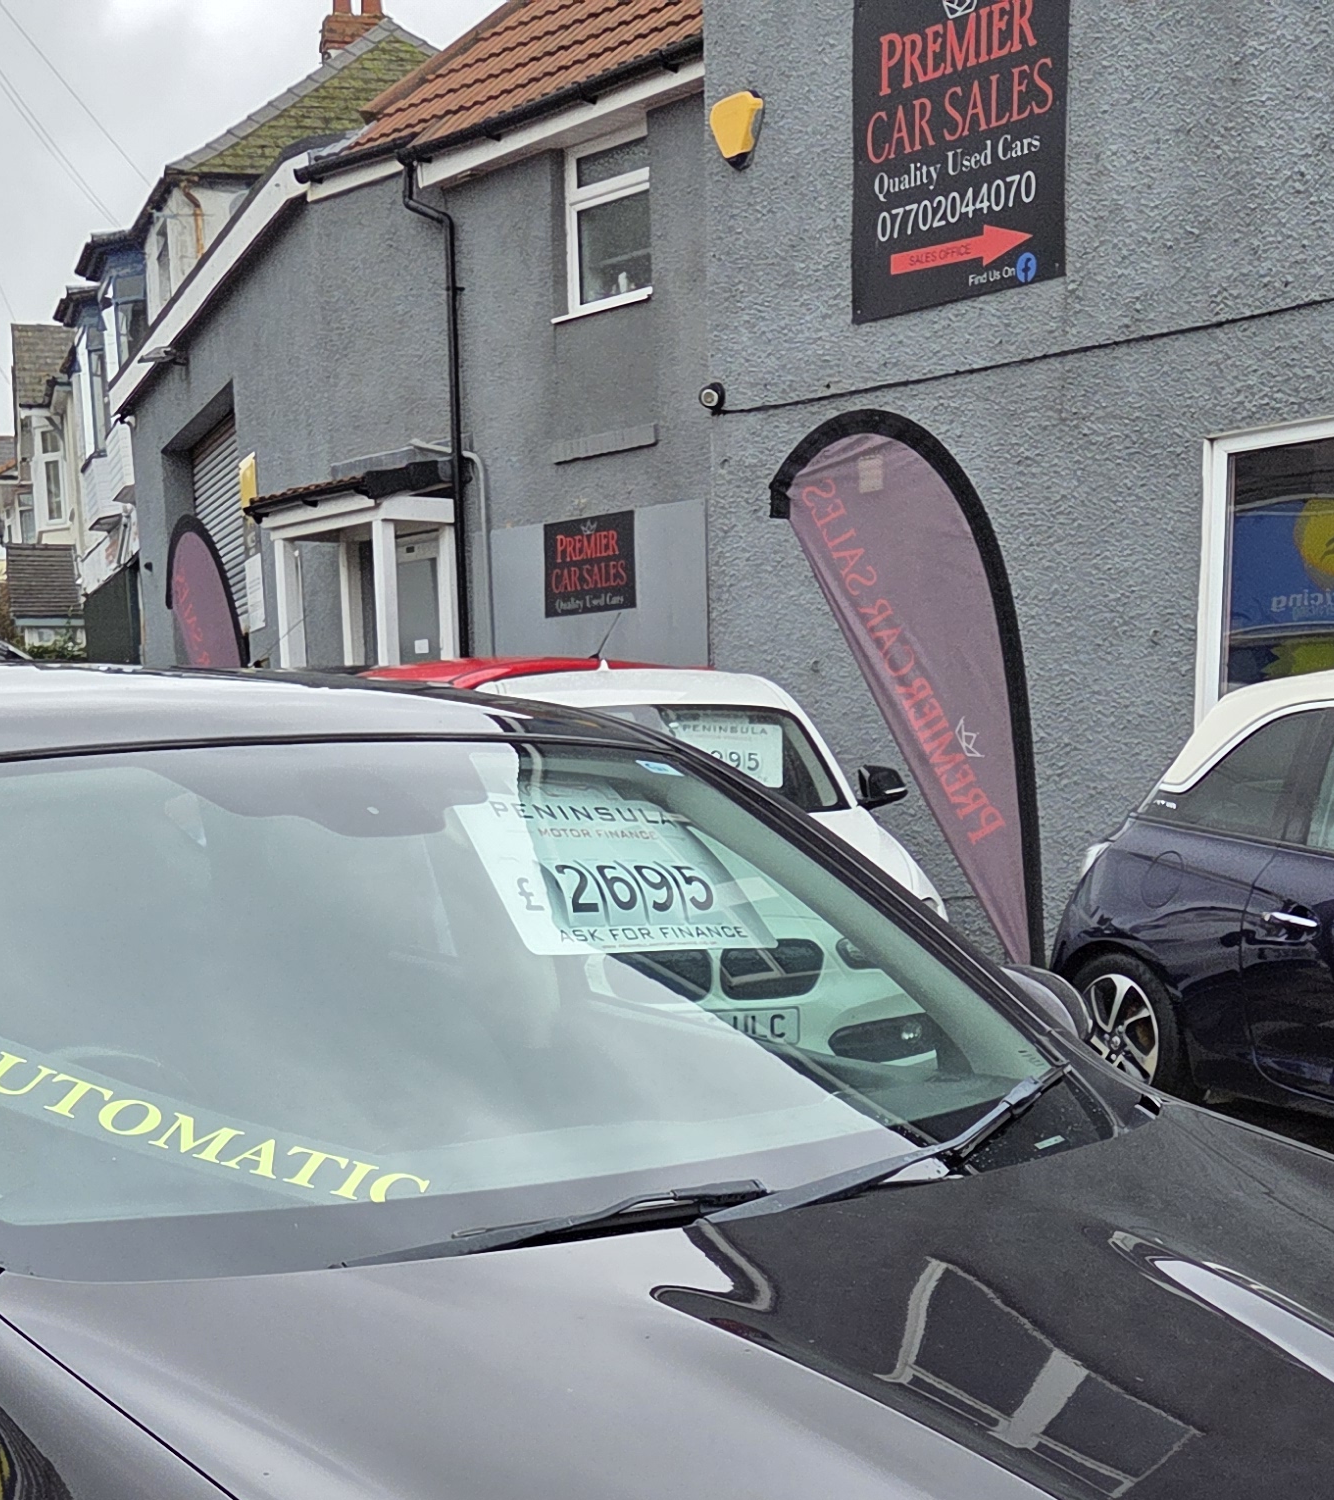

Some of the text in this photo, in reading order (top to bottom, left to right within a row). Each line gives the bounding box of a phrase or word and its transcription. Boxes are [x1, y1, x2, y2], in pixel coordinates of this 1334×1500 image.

[879, 0, 1037, 96] PREMIER
[866, 57, 1054, 164] CAR SALES
[874, 133, 1041, 201] Quality Used Cars
[877, 170, 1037, 242] 07702044070
[909, 244, 972, 267] SALES OFFICE
[968, 273, 987, 287] Find
[989, 268, 1001, 280] Us
[1002, 265, 1016, 278] On
[556, 530, 619, 563] PREMIER
[551, 560, 627, 593] CAR SALES
[682, 724, 768, 735] PENINSULA
[489, 800, 677, 828] PENINSULA
[537, 827, 659, 841] MOTOR FINANCE
[560, 925, 749, 943] ASK FOR FINANCE
